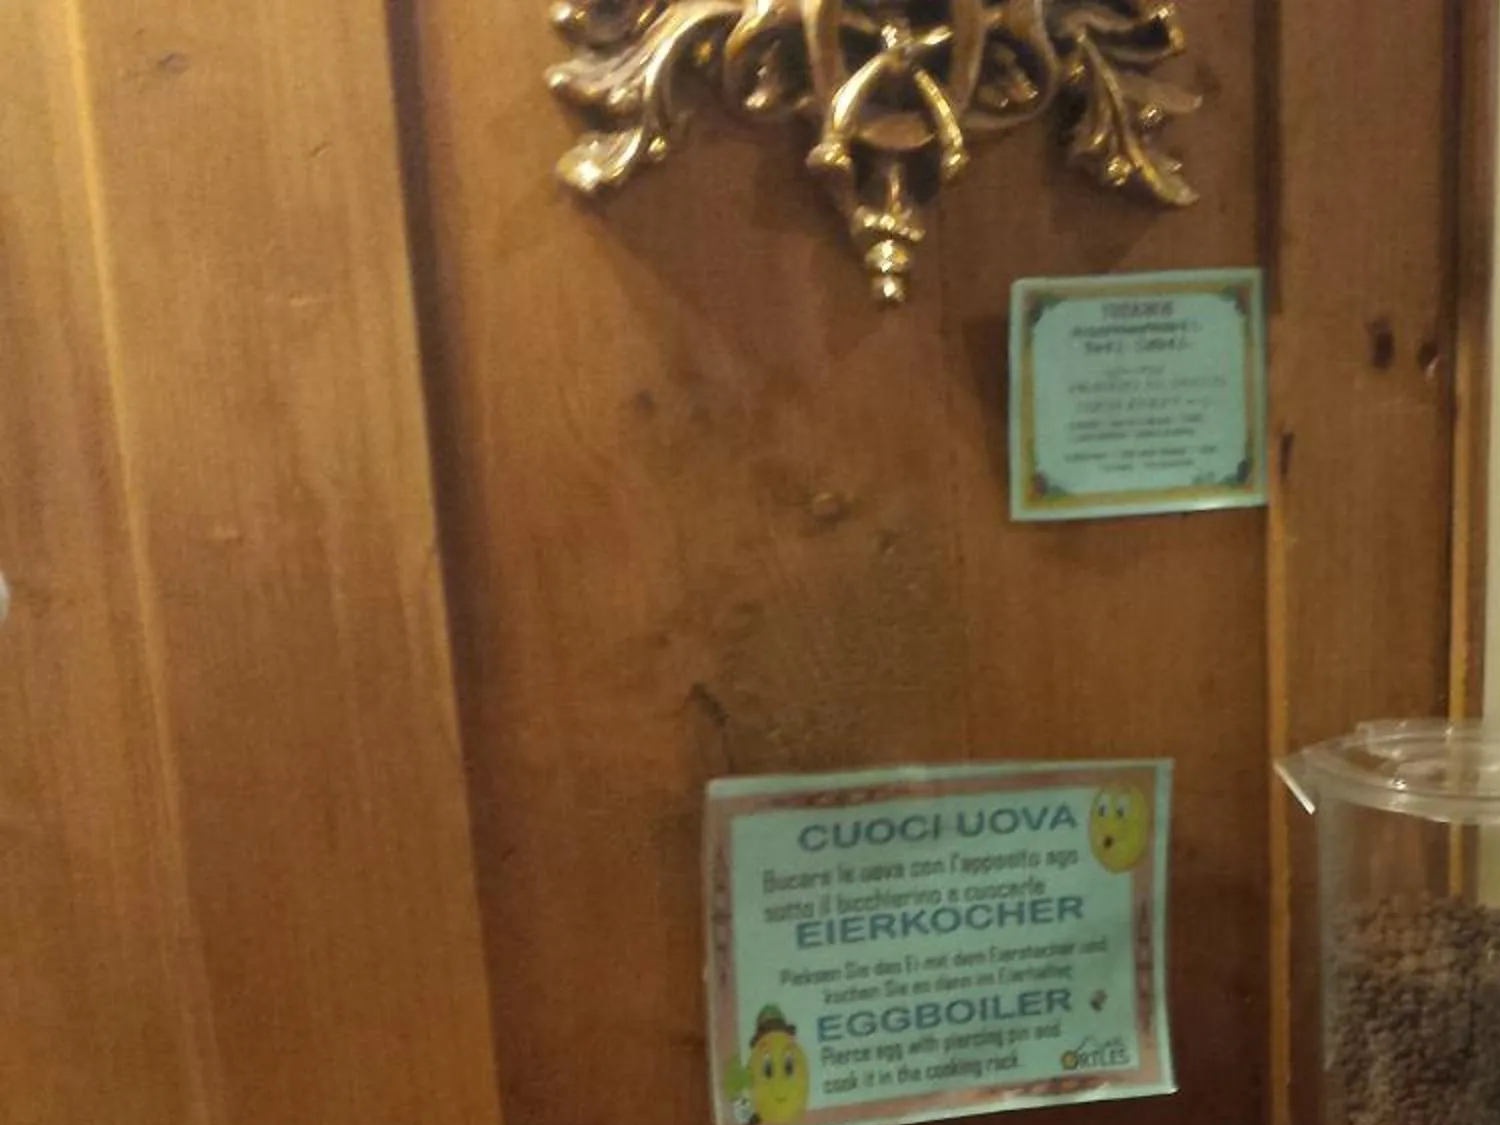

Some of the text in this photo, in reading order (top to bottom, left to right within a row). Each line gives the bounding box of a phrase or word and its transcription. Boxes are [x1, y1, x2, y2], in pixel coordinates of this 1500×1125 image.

[798, 802, 1077, 852] CUOCI UOVA
[796, 896, 1084, 949] EIERKOCHER
[817, 988, 1073, 1043] EGGBOILER
